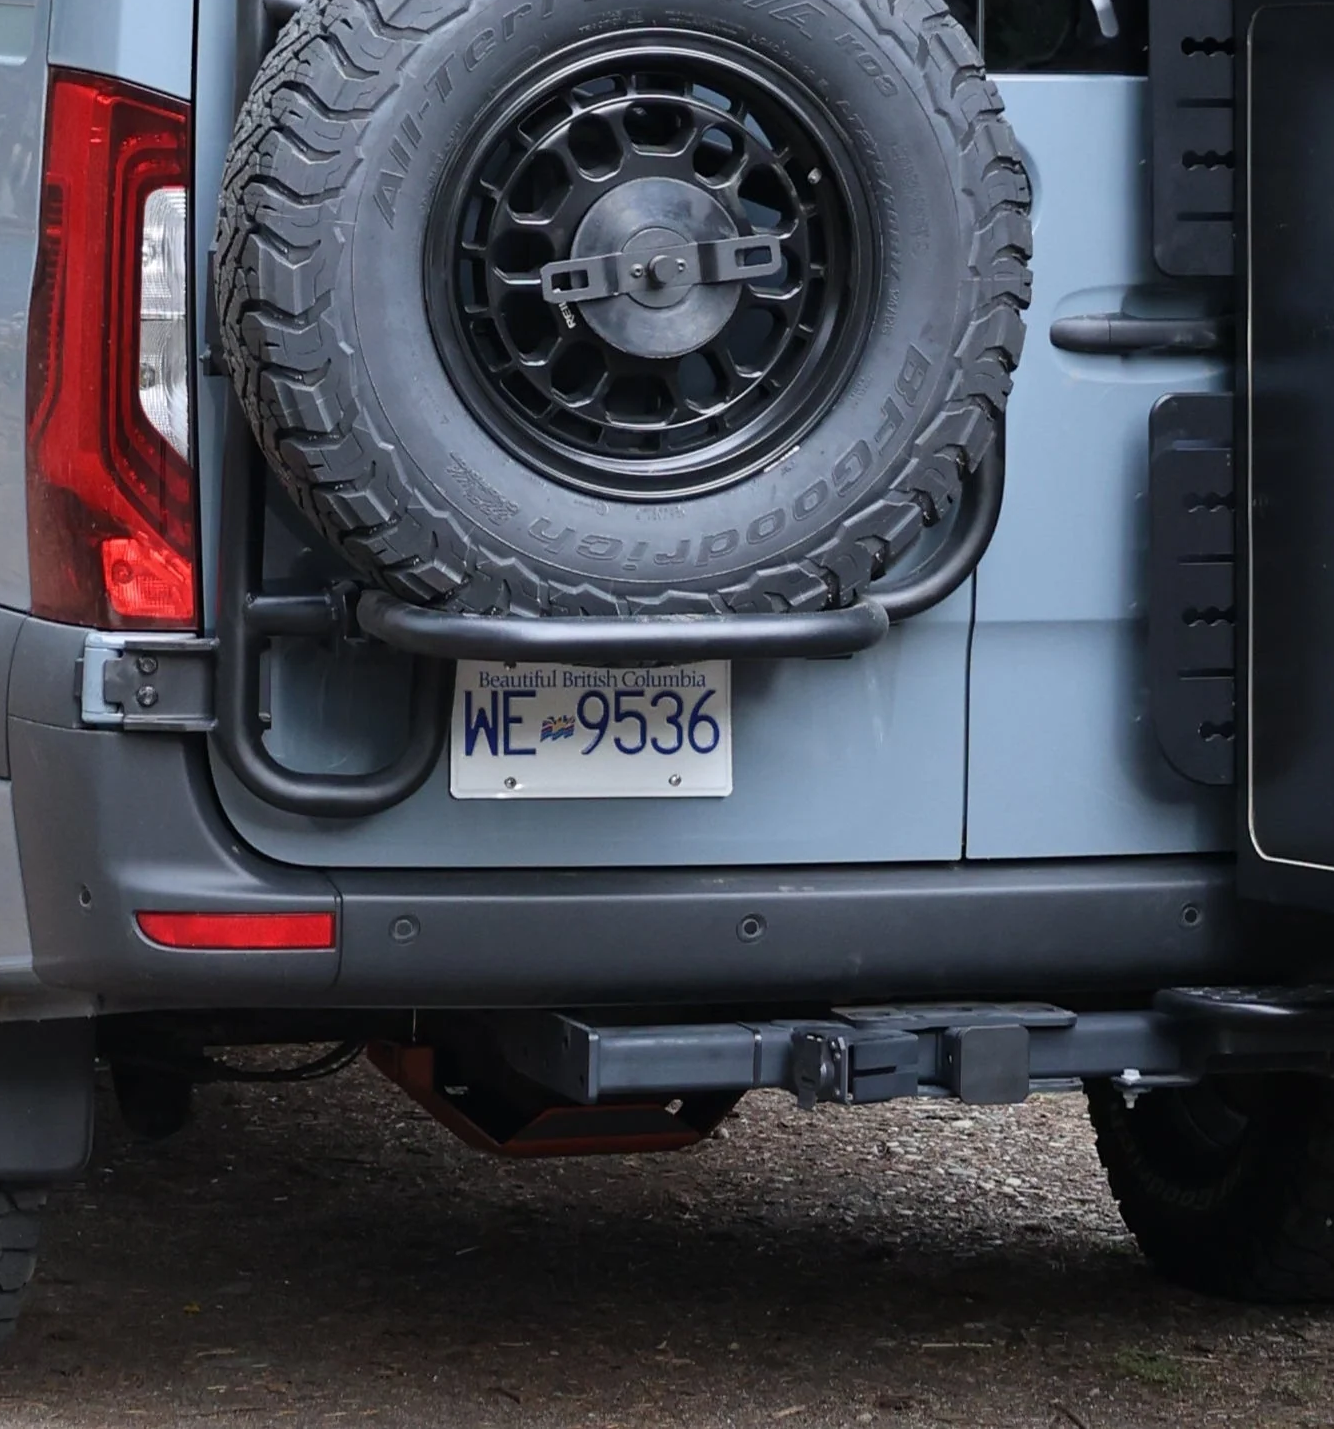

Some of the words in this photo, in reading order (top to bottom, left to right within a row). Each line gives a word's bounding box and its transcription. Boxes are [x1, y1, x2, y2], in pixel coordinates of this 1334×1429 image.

[834, 28, 900, 100] KO3
[527, 343, 937, 573] BFGoodrich
[479, 670, 556, 688] Beautiful
[562, 670, 618, 688] British
[621, 670, 706, 688] Columbia
[464, 689, 536, 756] WE
[576, 689, 720, 755] 9536
